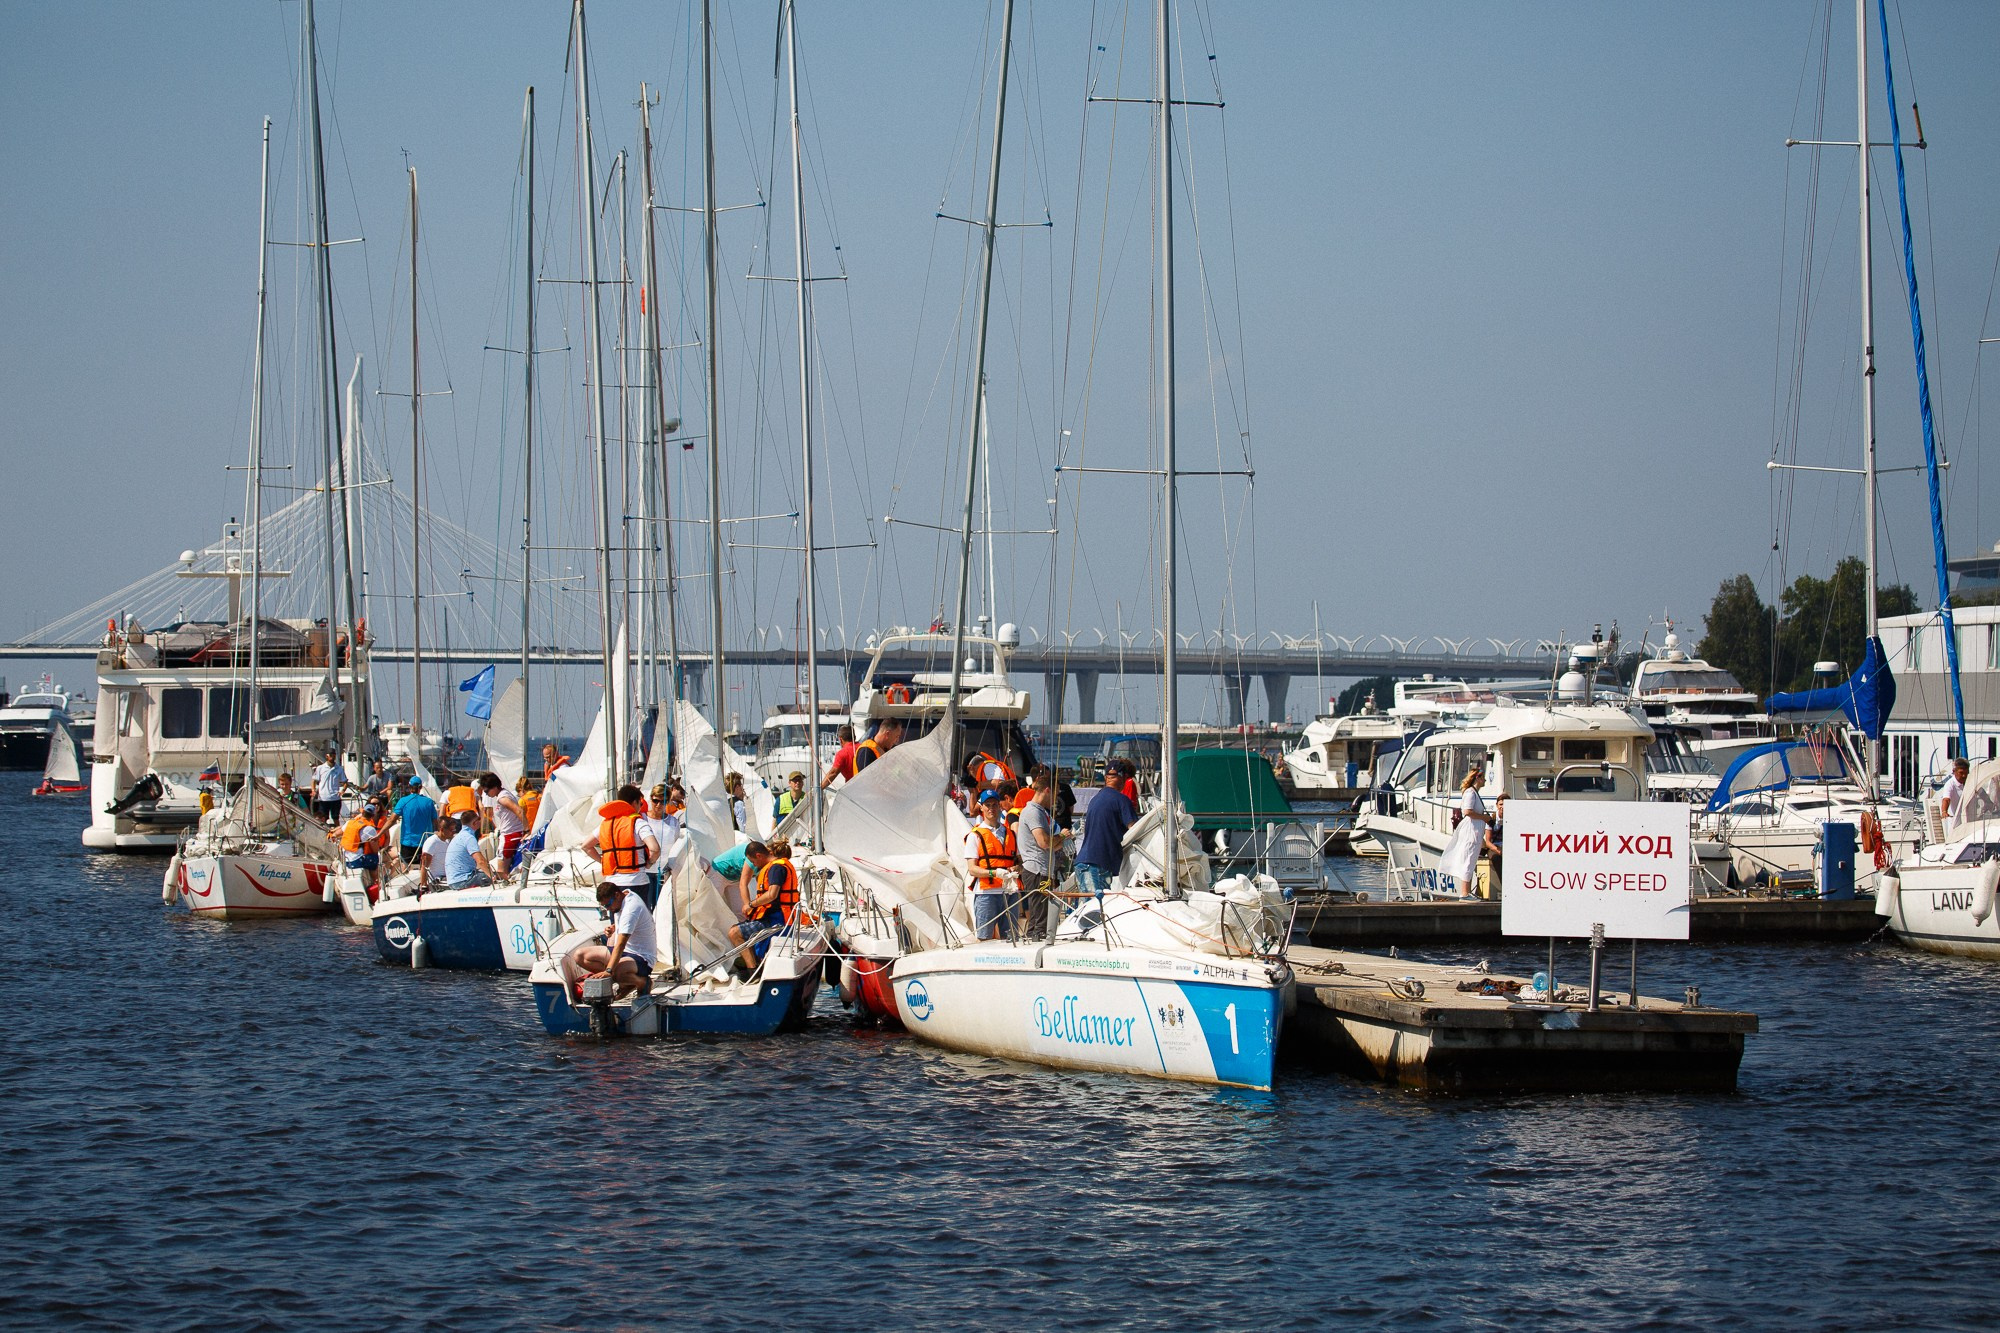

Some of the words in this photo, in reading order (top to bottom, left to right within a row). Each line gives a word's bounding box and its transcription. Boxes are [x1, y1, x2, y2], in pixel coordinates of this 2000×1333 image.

[1520, 830, 1609, 853] ТИХИЙ
[1617, 835, 1673, 858] ХОД
[258, 864, 292, 881] Корсар
[1523, 871, 1587, 890] SLOW
[1594, 873, 1667, 891] SPEED
[353, 897, 363, 910] 8
[1932, 892, 1974, 910] LANA
[1056, 957, 1130, 970] www.yachtschoolspb.ru
[1203, 964, 1235, 979] ALPHA
[545, 991, 561, 1014] 7
[1033, 995, 1136, 1047] Bellamer
[1224, 1003, 1239, 1054] 1
